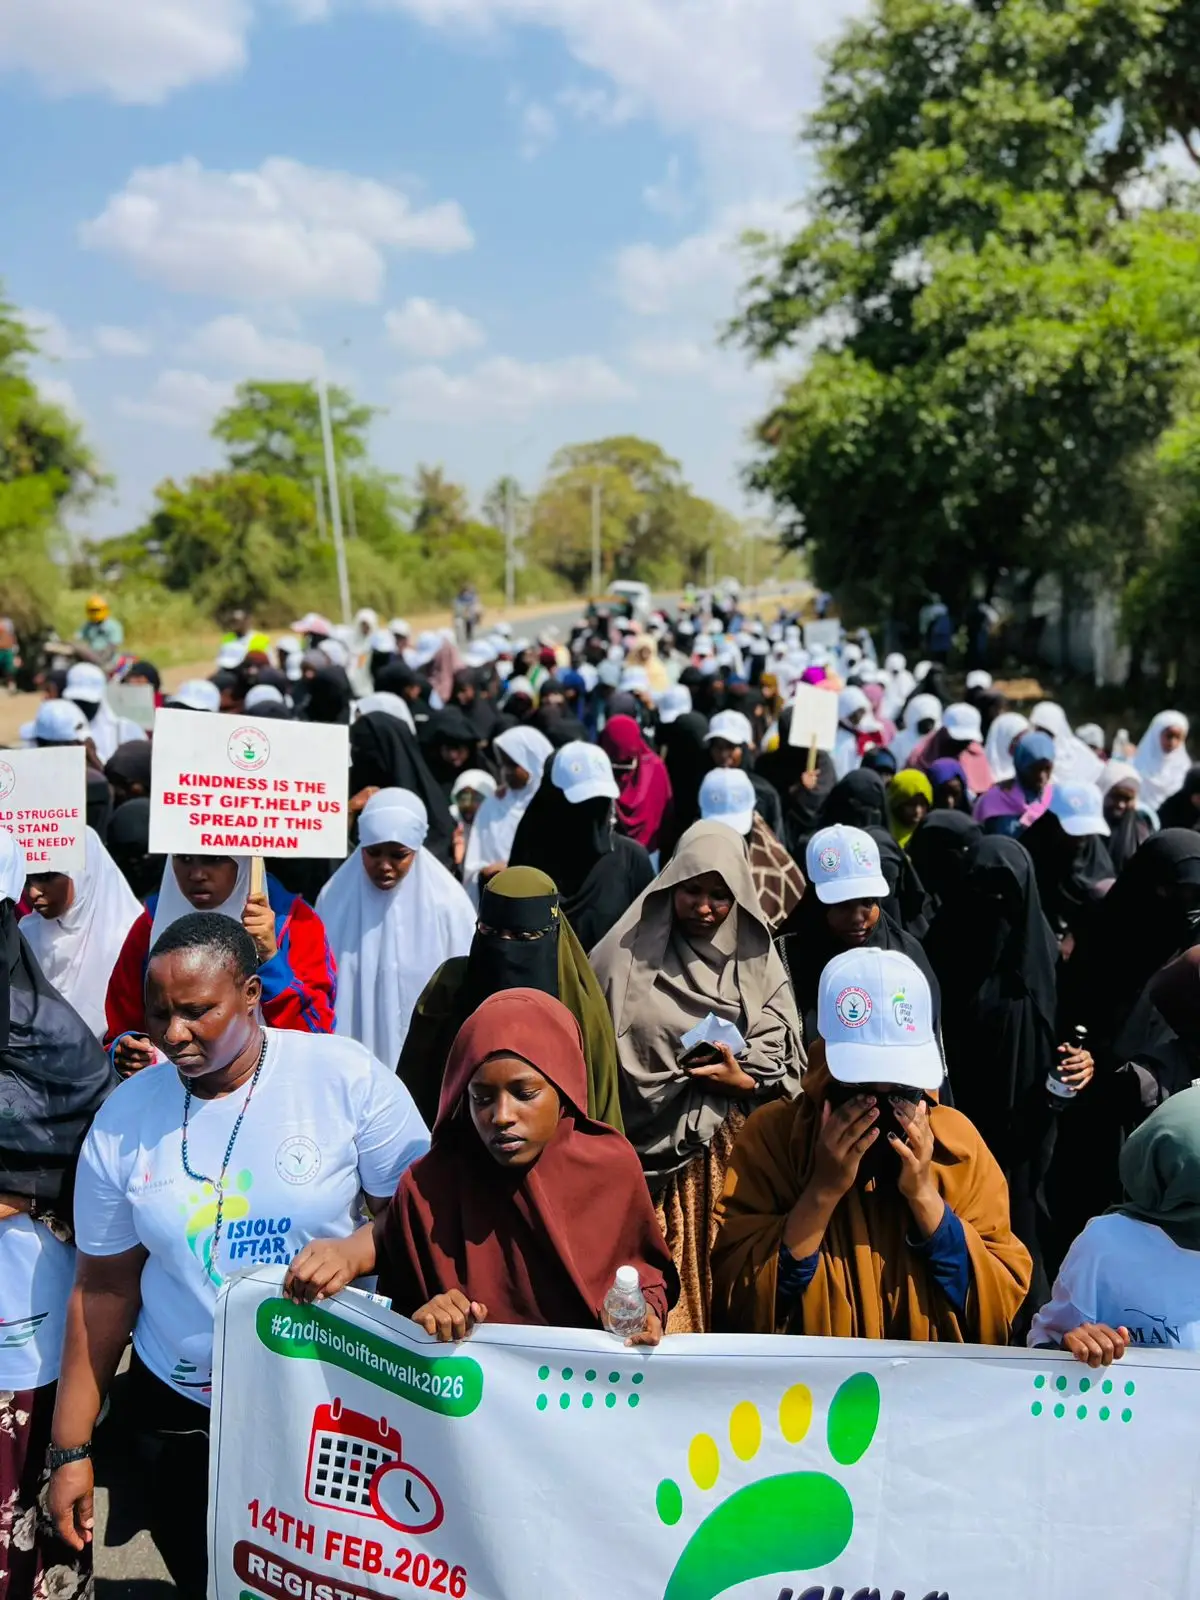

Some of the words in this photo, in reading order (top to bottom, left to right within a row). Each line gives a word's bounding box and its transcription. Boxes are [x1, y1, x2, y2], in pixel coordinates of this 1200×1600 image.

[179, 774, 268, 790] KINDNESS
[274, 780, 288, 791] IS
[295, 782, 326, 794] THE
[163, 792, 213, 806] BEST
[220, 796, 311, 812] GIFT.HELP
[318, 801, 340, 813] US
[17, 809, 78, 820] STRUGGLE
[189, 813, 258, 828] SPREAD
[264, 817, 279, 829] IT
[285, 818, 322, 830] THIS
[18, 823, 58, 833] STAND
[16, 839, 34, 848] HE
[38, 837, 75, 847] NEEDY
[201, 834, 298, 848] RAMADHAN
[227, 1217, 291, 1239] ISIOLO
[230, 1237, 286, 1260] IFTAR
[271, 1314, 464, 1399] #2ndisioloiftarwalk2026
[247, 1499, 315, 1554] 14TH
[324, 1530, 467, 1599] FEB.2026
[248, 1552, 372, 1600] REGIST
